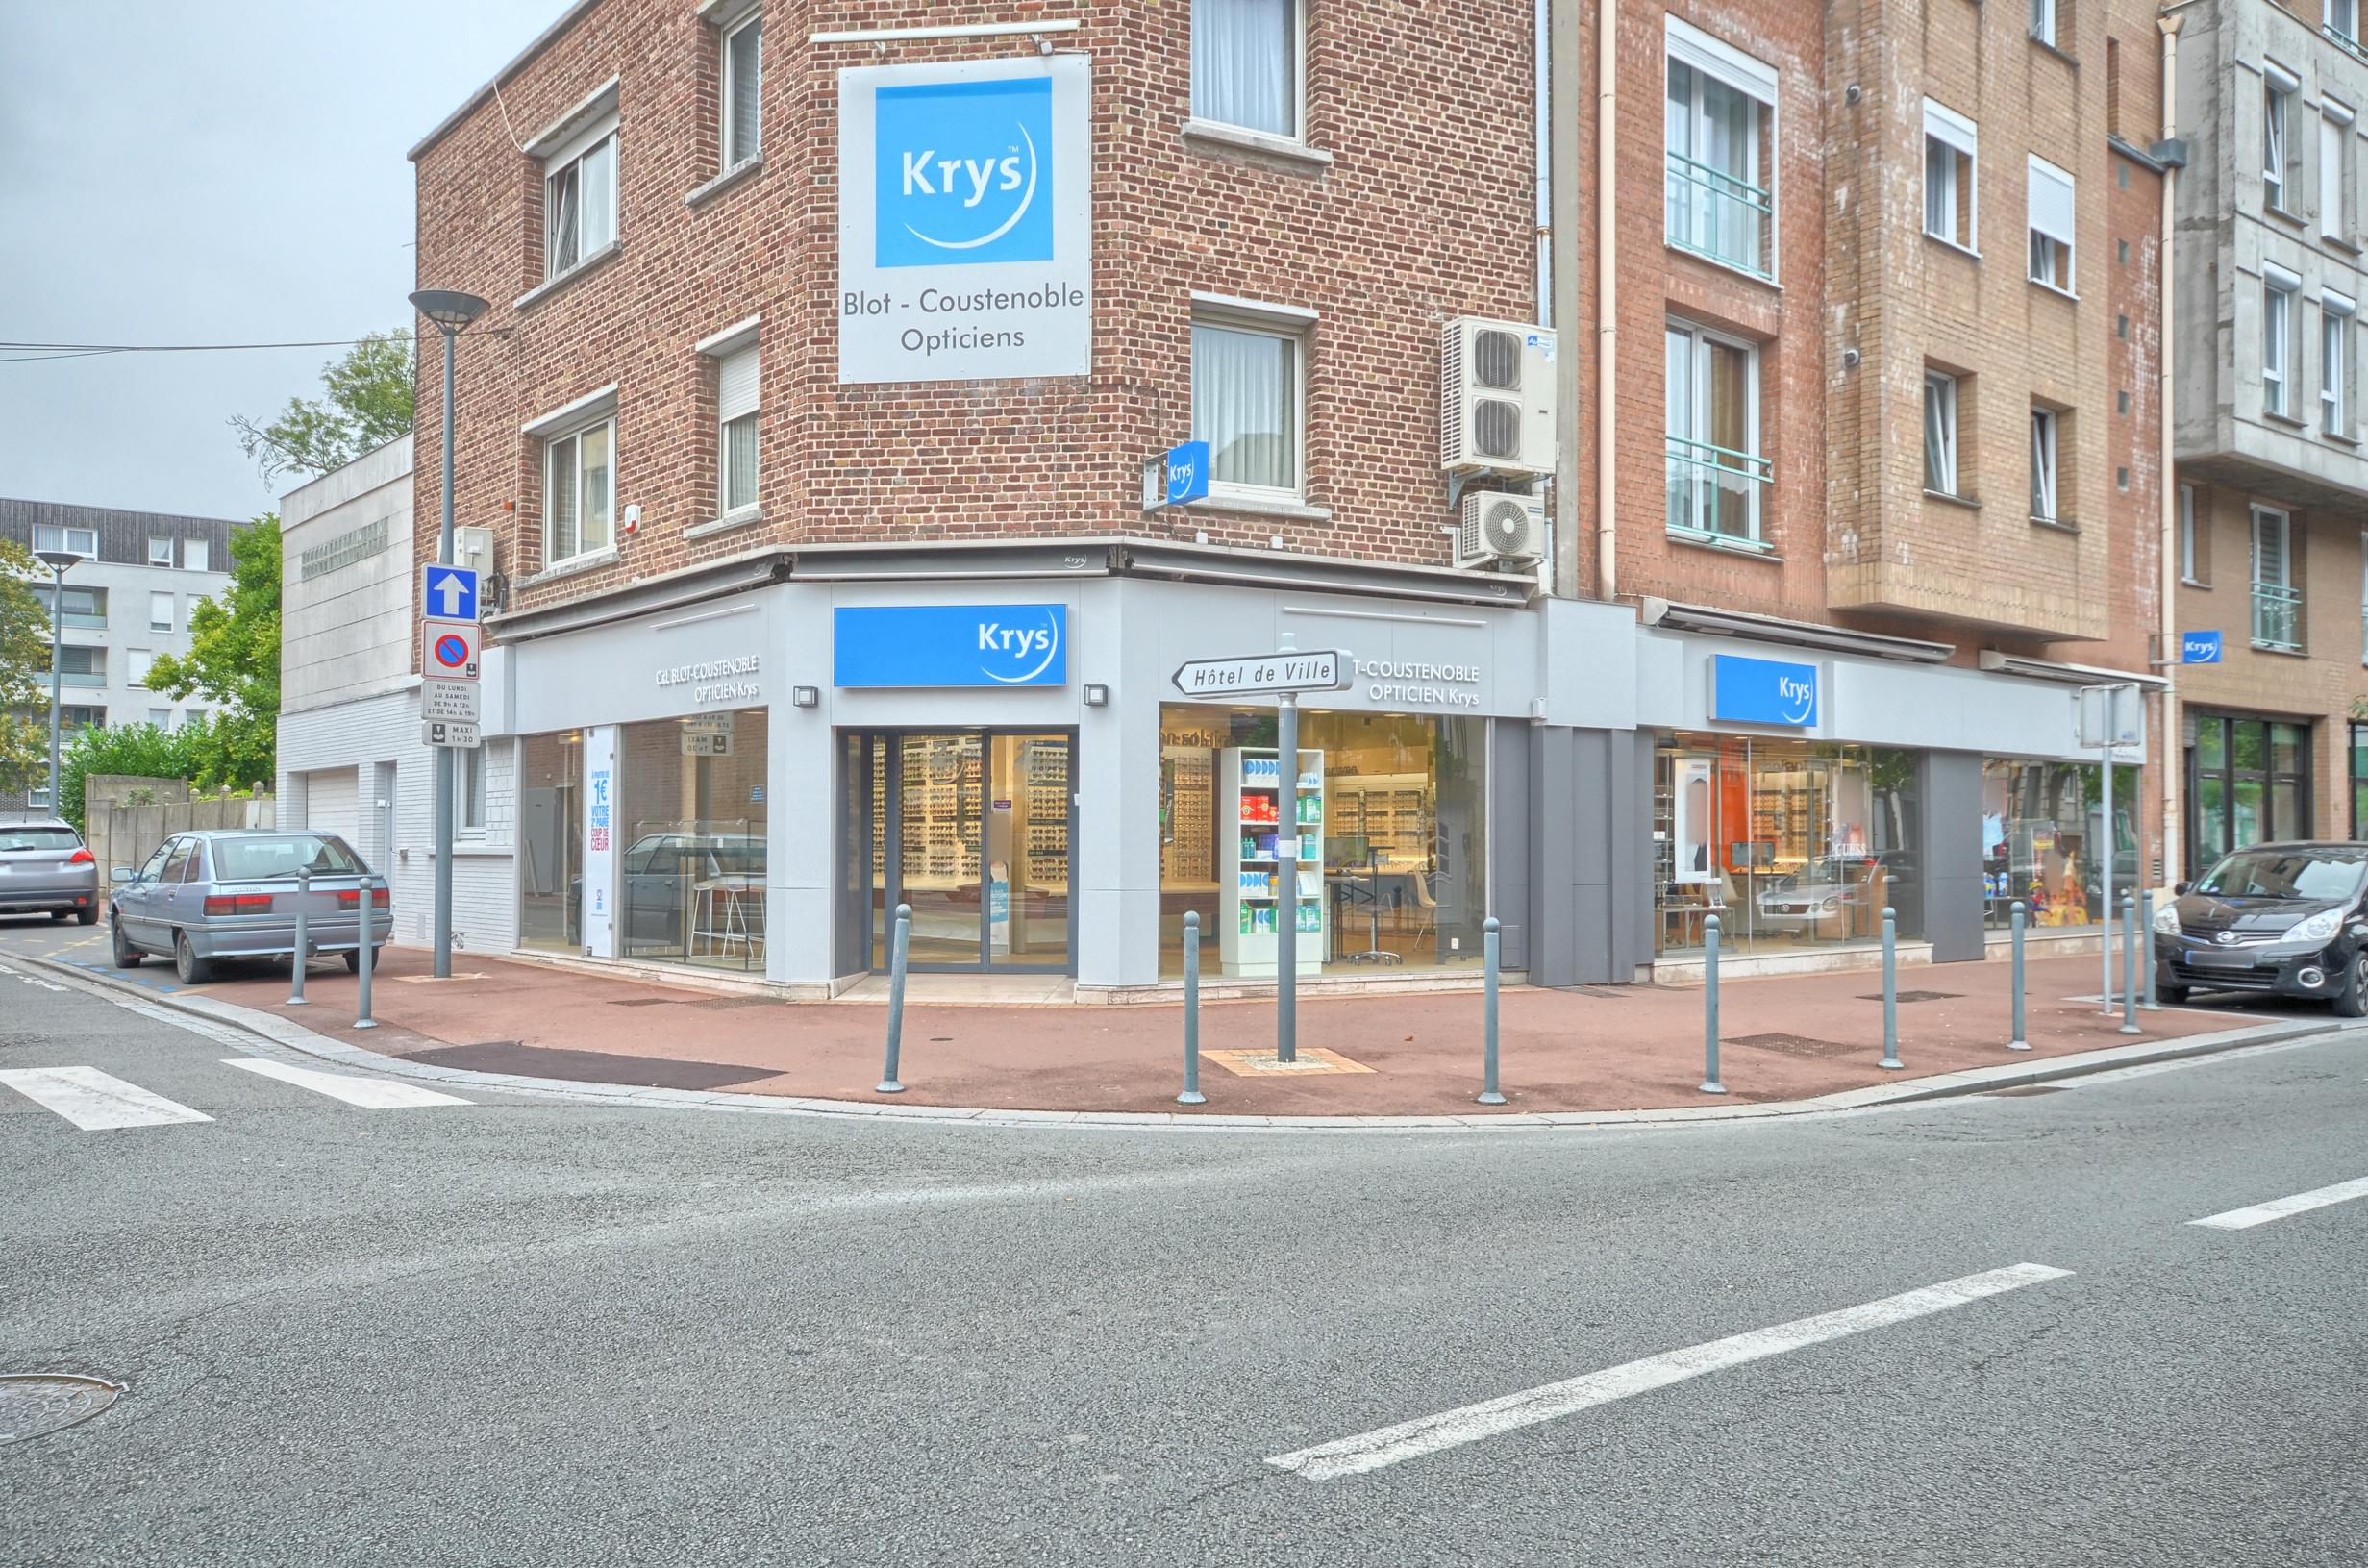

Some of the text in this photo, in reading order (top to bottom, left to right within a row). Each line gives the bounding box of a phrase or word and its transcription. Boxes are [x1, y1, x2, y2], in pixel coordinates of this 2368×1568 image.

[903, 150, 1022, 208] Krys
[844, 290, 891, 316] Blot
[919, 282, 1084, 312] Coustenoble
[901, 326, 1025, 357] Opticiens
[1170, 463, 1191, 484] Krys
[979, 623, 1049, 659] Krys
[2185, 641, 2214, 655] Krys
[671, 654, 758, 683] BLOT-COUSTENOBLE
[1194, 661, 1331, 686] Hôtel de Ville
[694, 679, 759, 703] OPTICIEN Krys
[1369, 684, 1480, 709] OPTICIEN Krys
[1780, 676, 1810, 706] Krys
[594, 779, 608, 805] 1€
[591, 805, 610, 817] VOTRE
